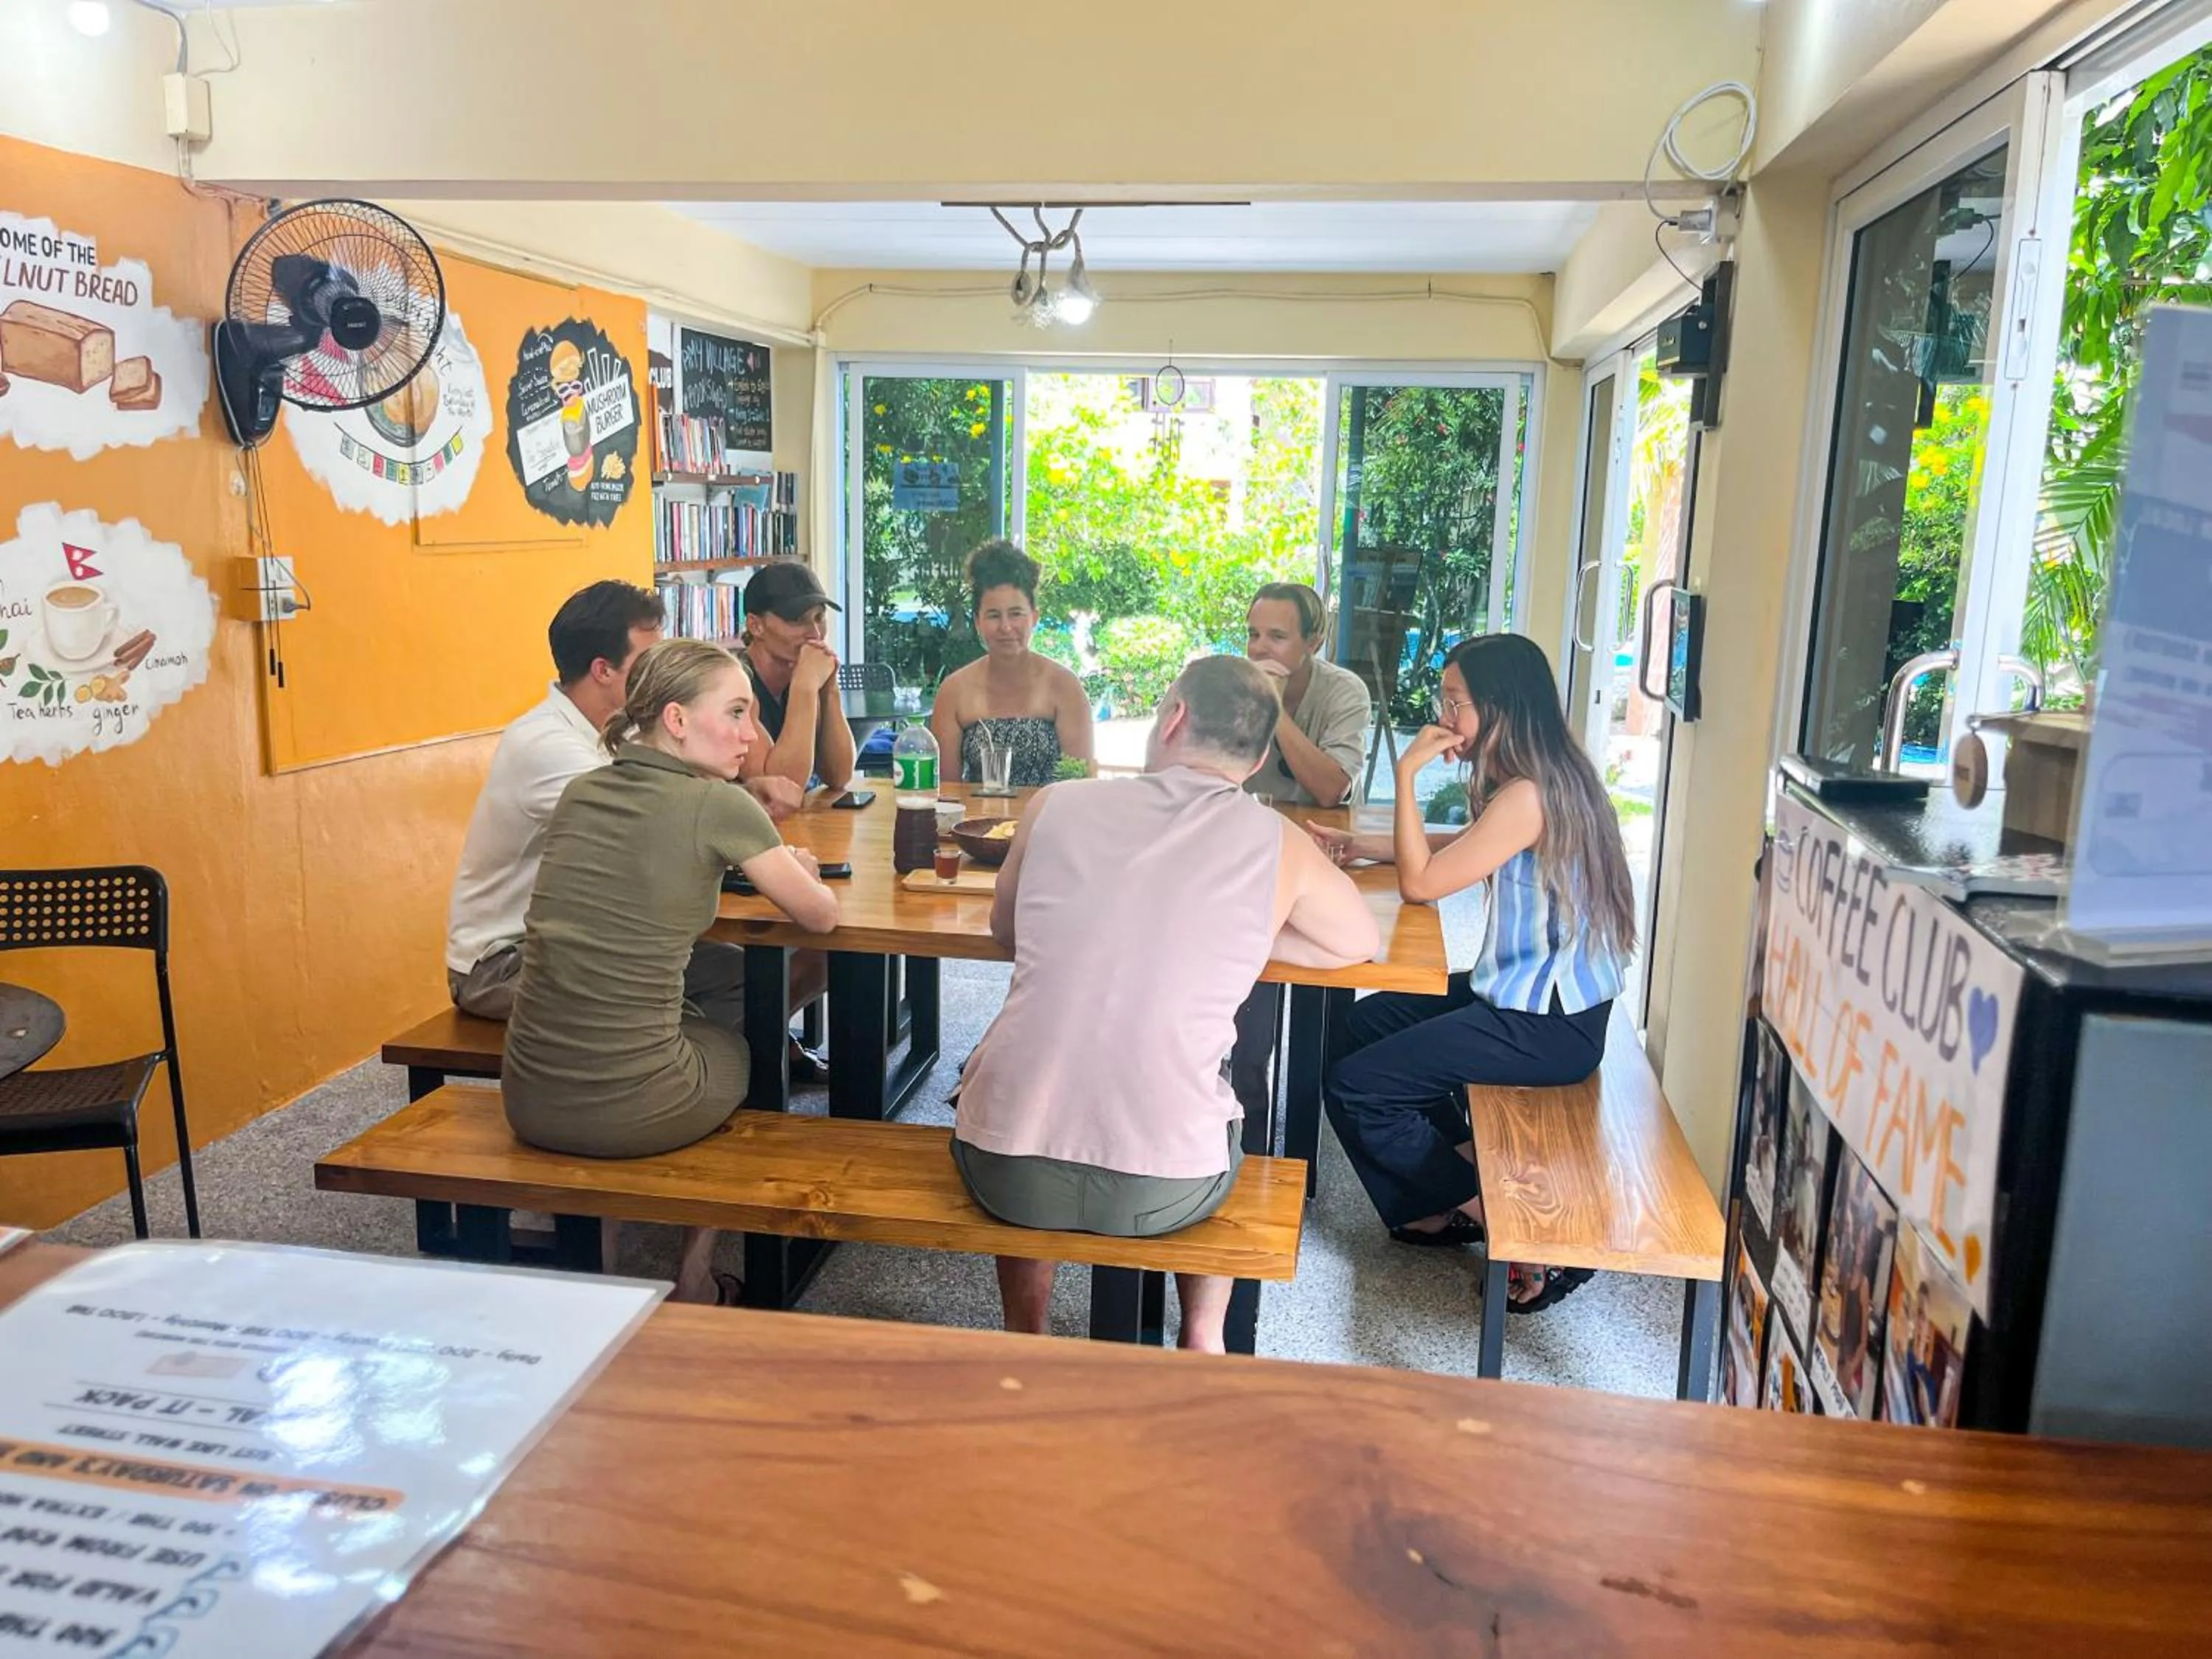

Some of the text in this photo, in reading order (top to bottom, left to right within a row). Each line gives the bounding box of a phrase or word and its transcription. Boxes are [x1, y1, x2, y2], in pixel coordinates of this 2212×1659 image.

[41, 236, 63, 258] OF
[66, 241, 96, 265] THE
[74, 271, 139, 307] BREAD
[596, 403, 625, 434] BURGER
[93, 703, 139, 736] ginger
[1793, 825, 1972, 1062] COFFEE CLUB
[1766, 919, 1966, 1246] HALL OF FAME
[75, 1389, 156, 1411] PACK
[57, 1424, 128, 1441] STREET
[134, 1433, 184, 1449] WALL
